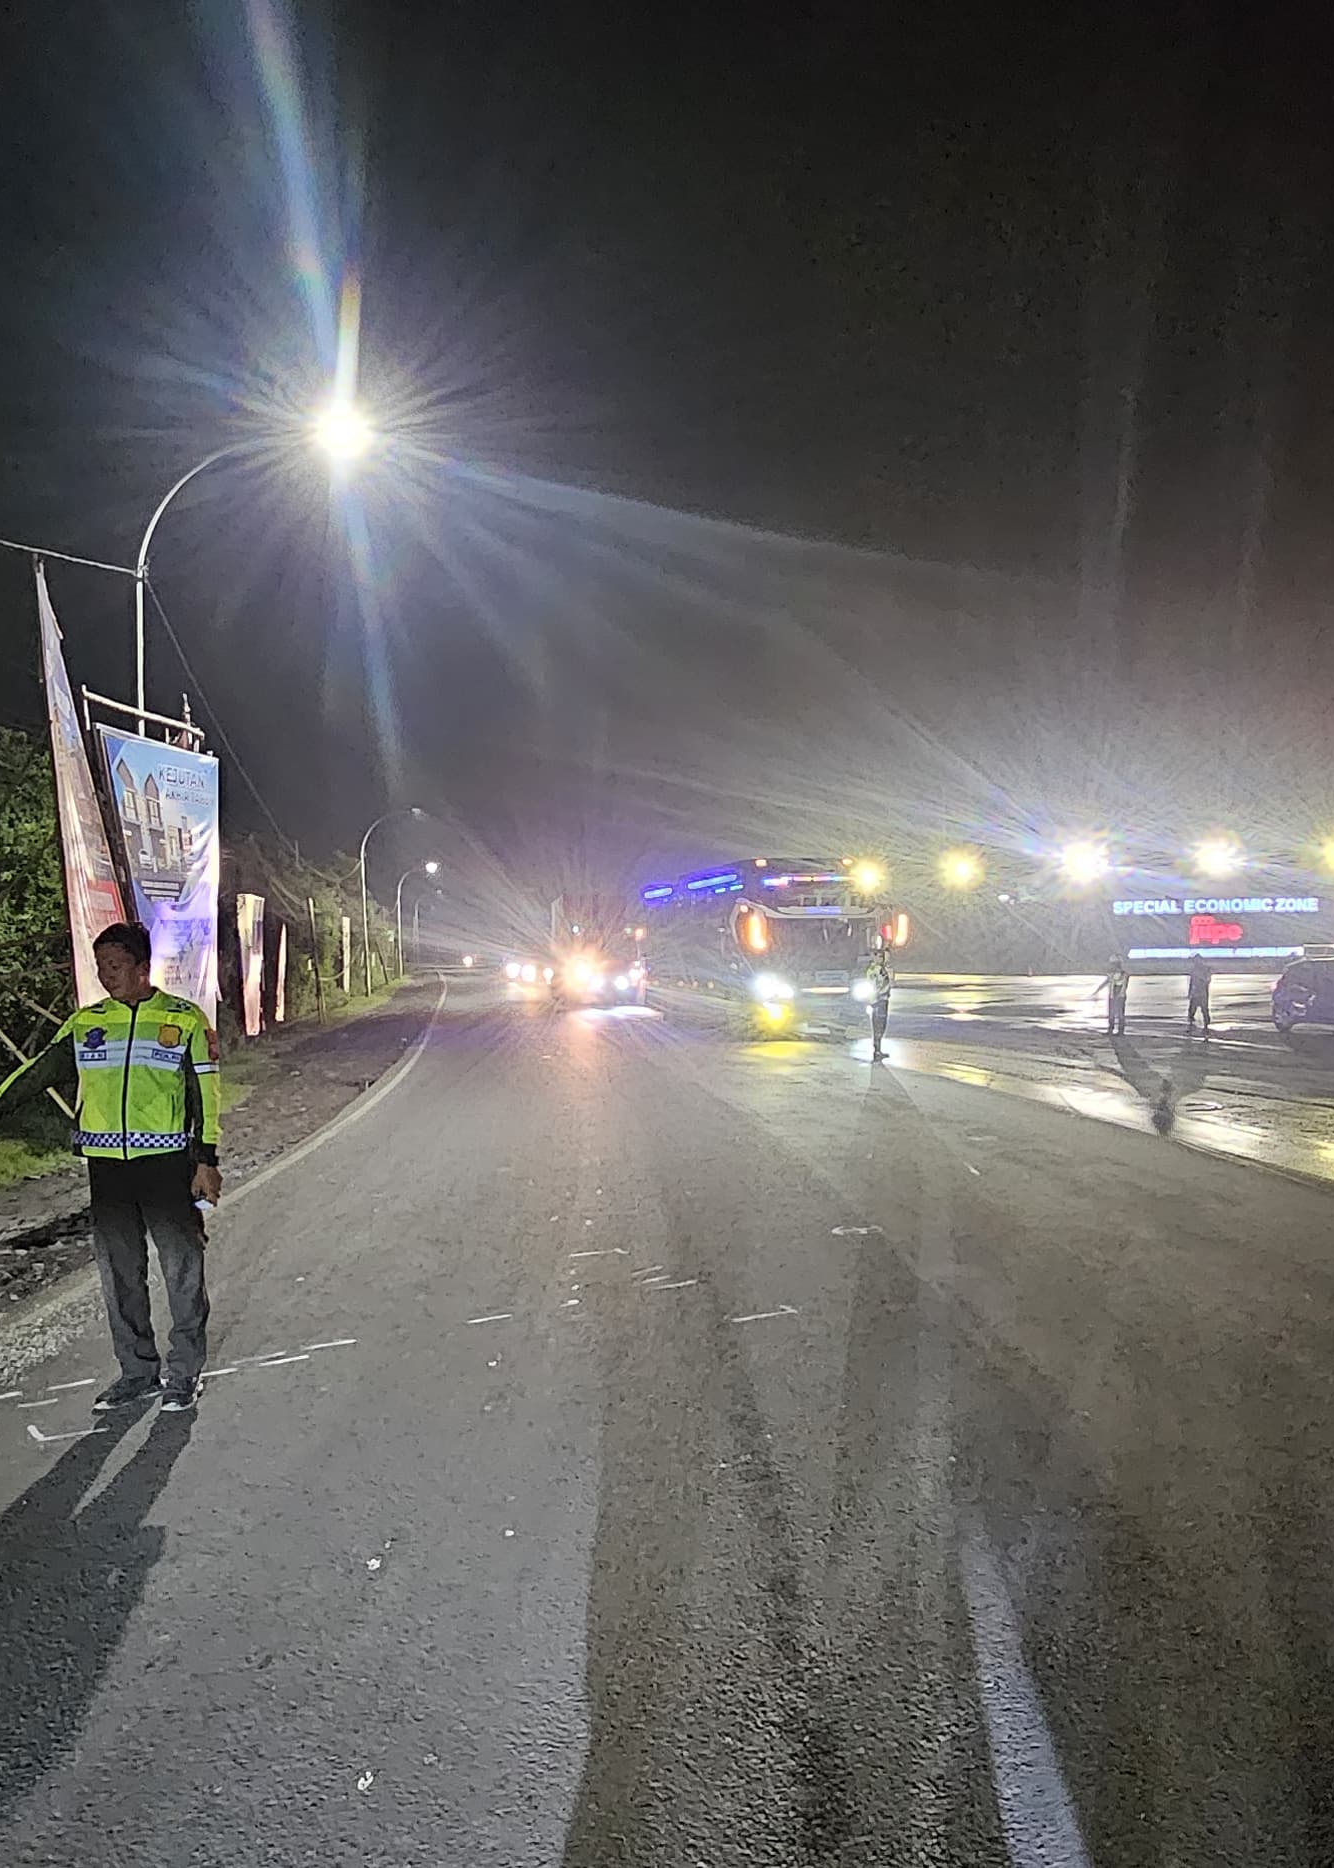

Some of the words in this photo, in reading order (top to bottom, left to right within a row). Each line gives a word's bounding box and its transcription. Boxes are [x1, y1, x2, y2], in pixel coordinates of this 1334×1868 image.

[1113, 900, 1181, 915] SPECIAL
[1183, 898, 1273, 914] ECONOMIC
[1274, 898, 1319, 912] ZONE
